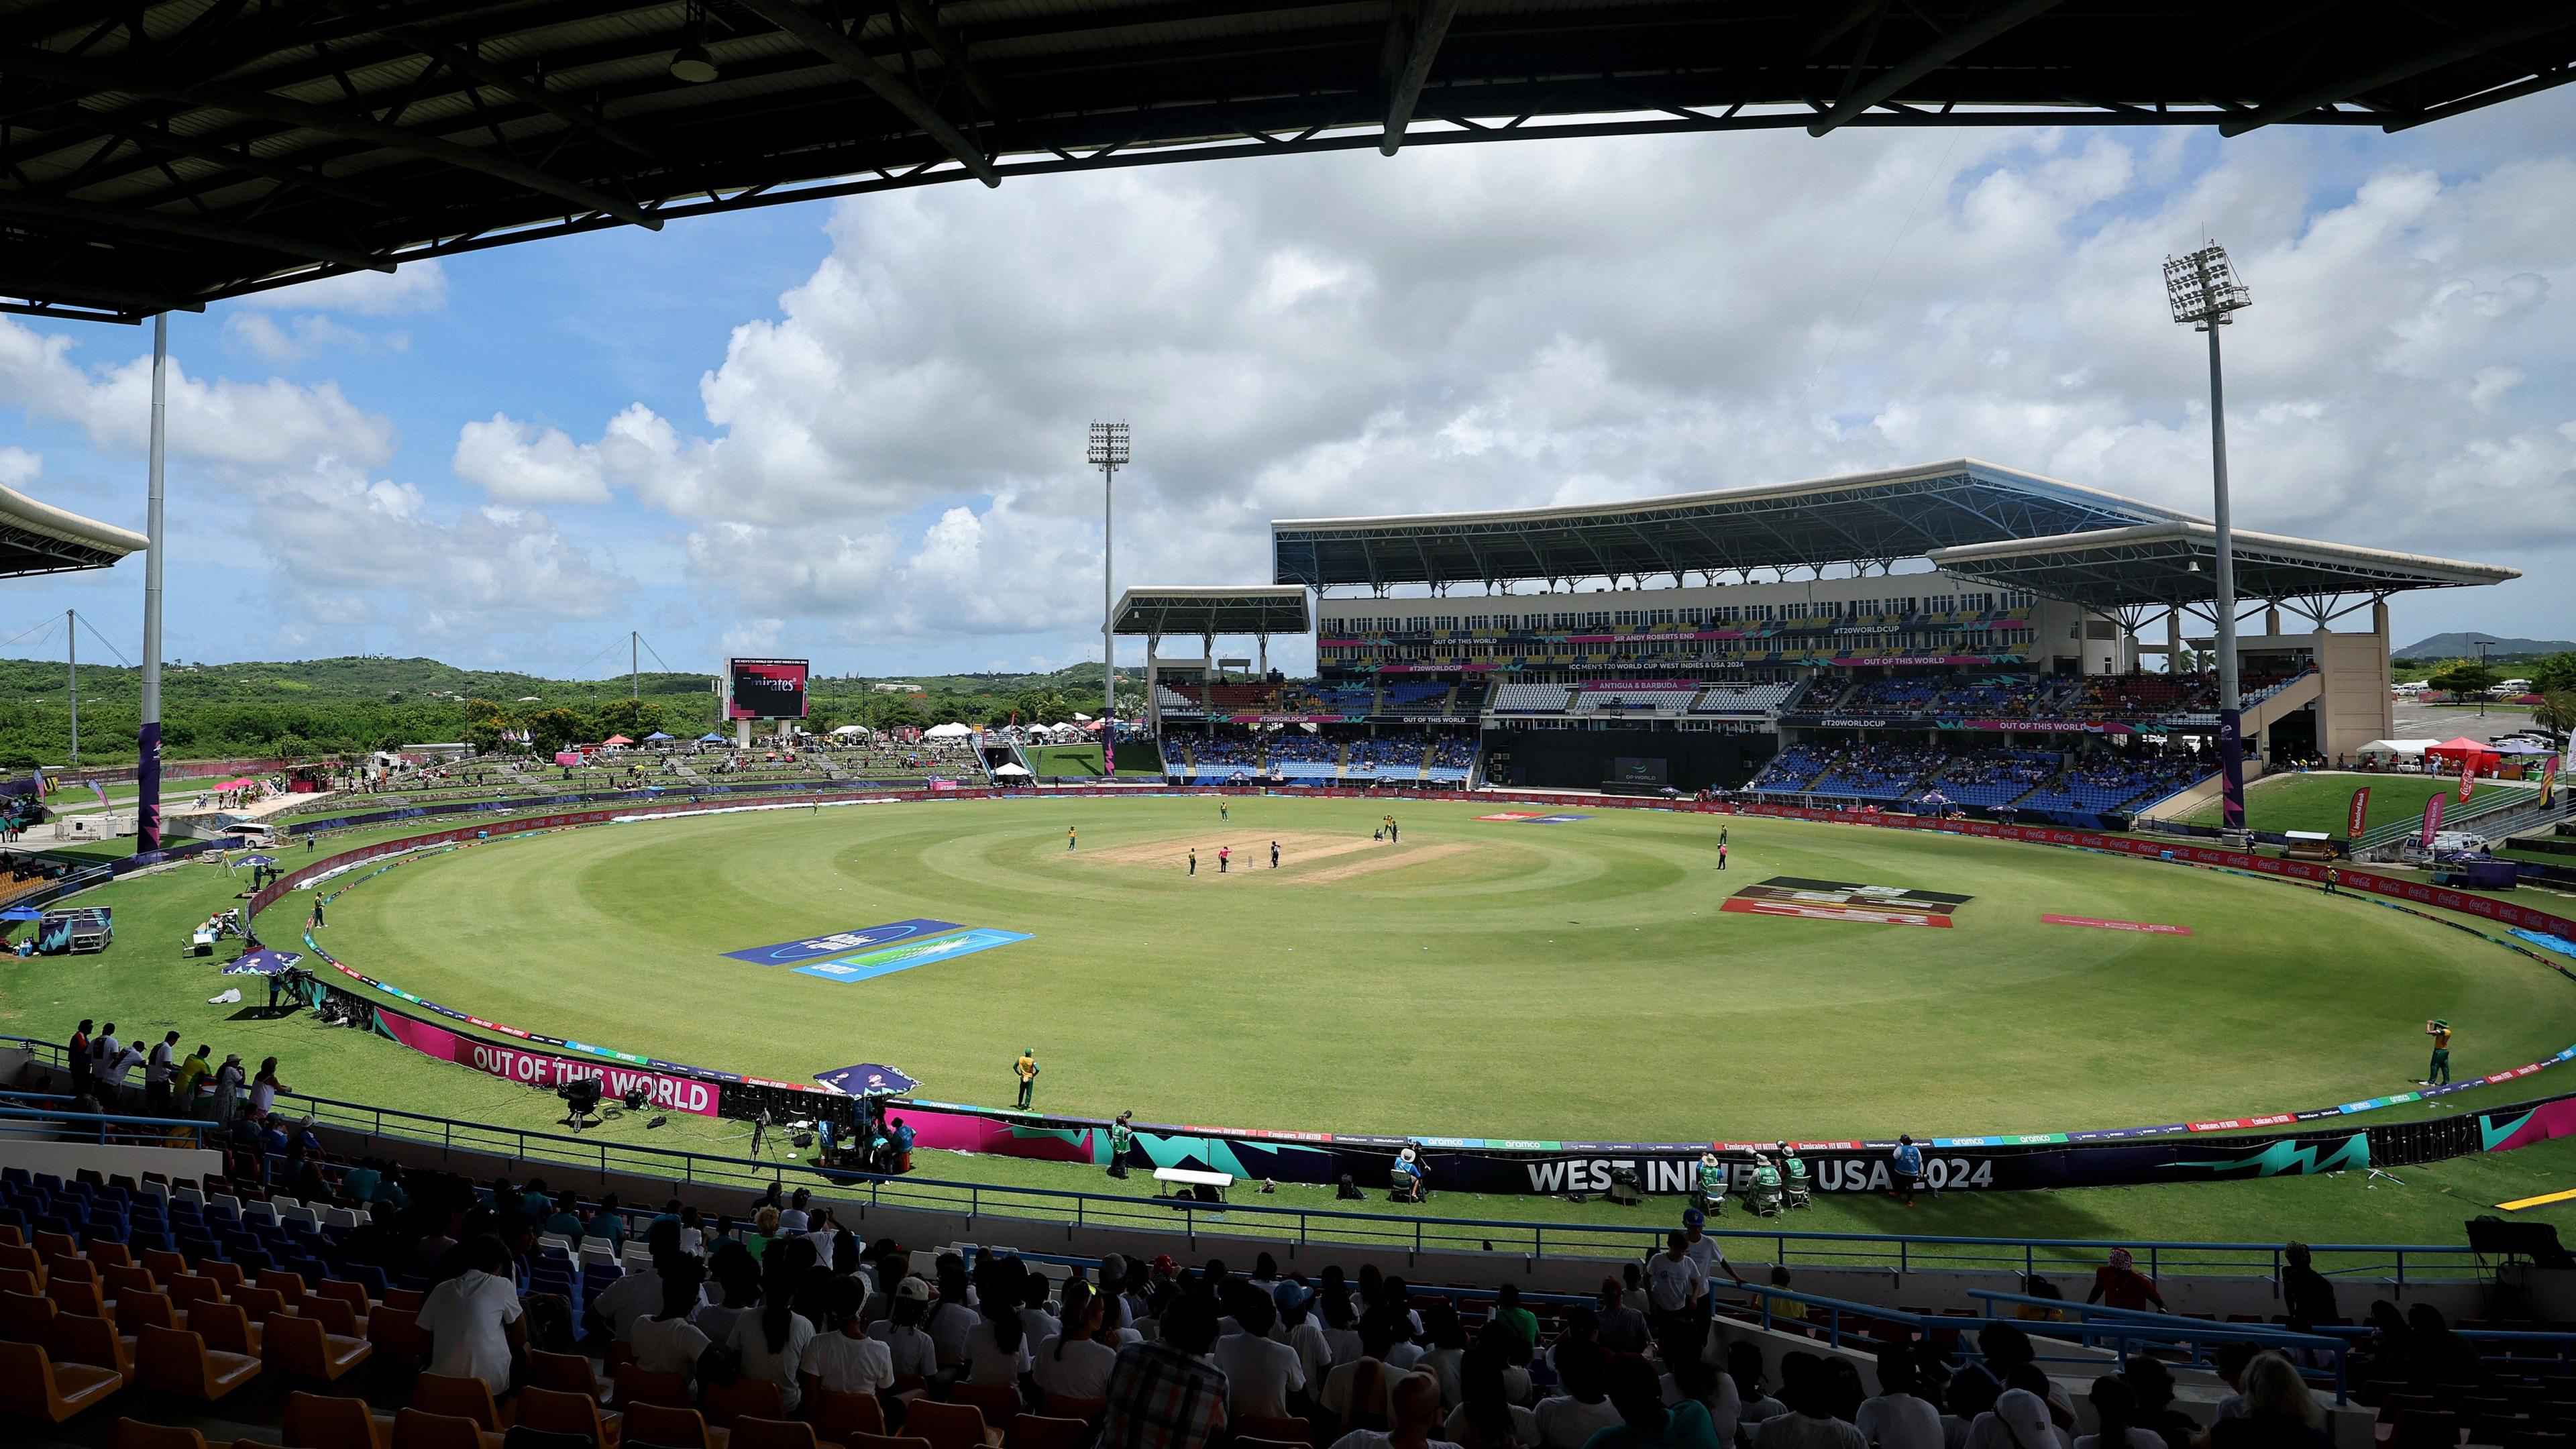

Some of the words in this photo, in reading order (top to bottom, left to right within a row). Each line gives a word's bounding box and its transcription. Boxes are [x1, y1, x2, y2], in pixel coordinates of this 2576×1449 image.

[1834, 626, 1899, 634] #T20WORLDCUP
[743, 677, 794, 691] mirates
[2460, 769, 2475, 796] Coca-Cola
[474, 1046, 514, 1073] OUT
[517, 1055, 547, 1082] OF
[610, 1071, 708, 1111] WORLD
[1428, 1138, 1463, 1146] aramco
[2020, 1135, 2051, 1143] aramco
[1648, 1161, 1771, 1191] INIE
[1818, 1160, 1893, 1191] USA
